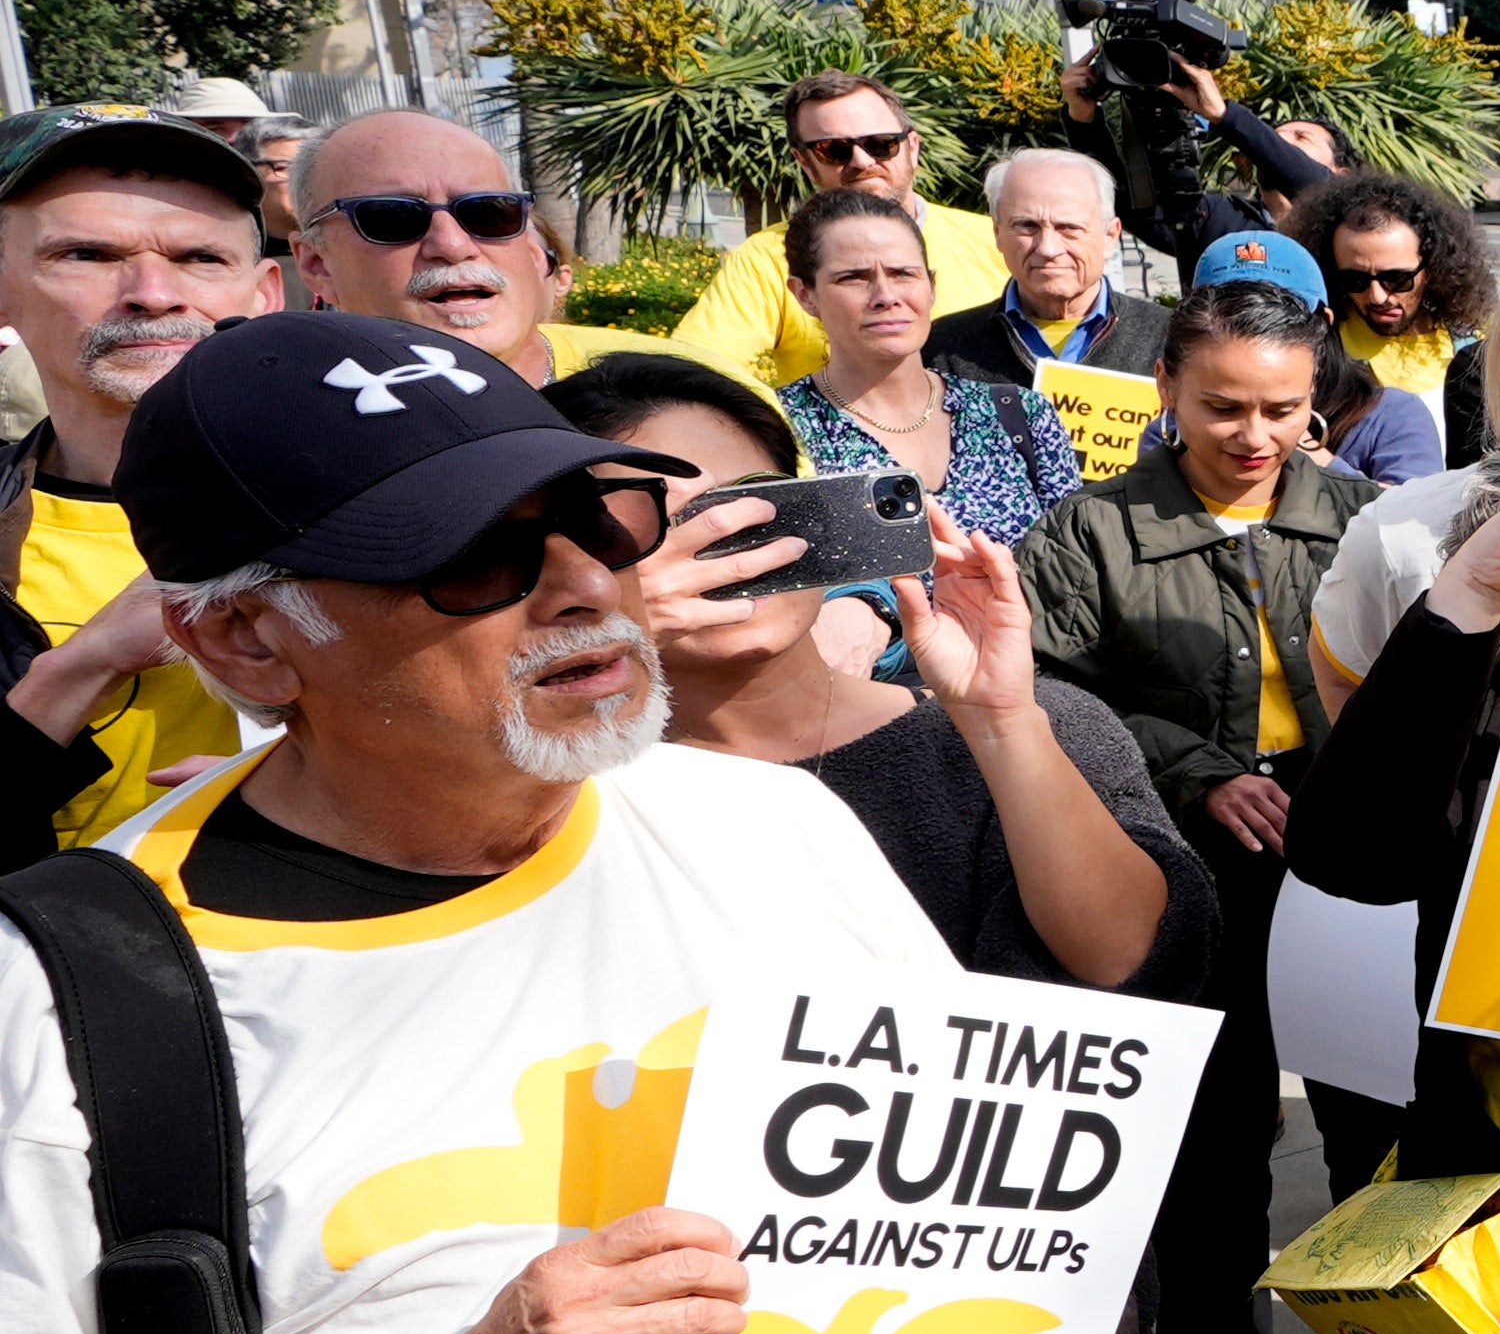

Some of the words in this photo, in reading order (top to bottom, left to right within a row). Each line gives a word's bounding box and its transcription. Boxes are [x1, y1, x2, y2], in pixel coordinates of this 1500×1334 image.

[1052, 392, 1093, 416] We
[1105, 407, 1159, 425] can'
[1092, 432, 1135, 450] our
[1091, 459, 1129, 475] wa
[781, 995, 919, 1076] L.A.
[946, 1015, 1149, 1099] TIMES
[763, 1082, 1122, 1212] GUILD
[737, 1214, 986, 1269] AGAINST
[986, 1226, 1090, 1274] ULPs
